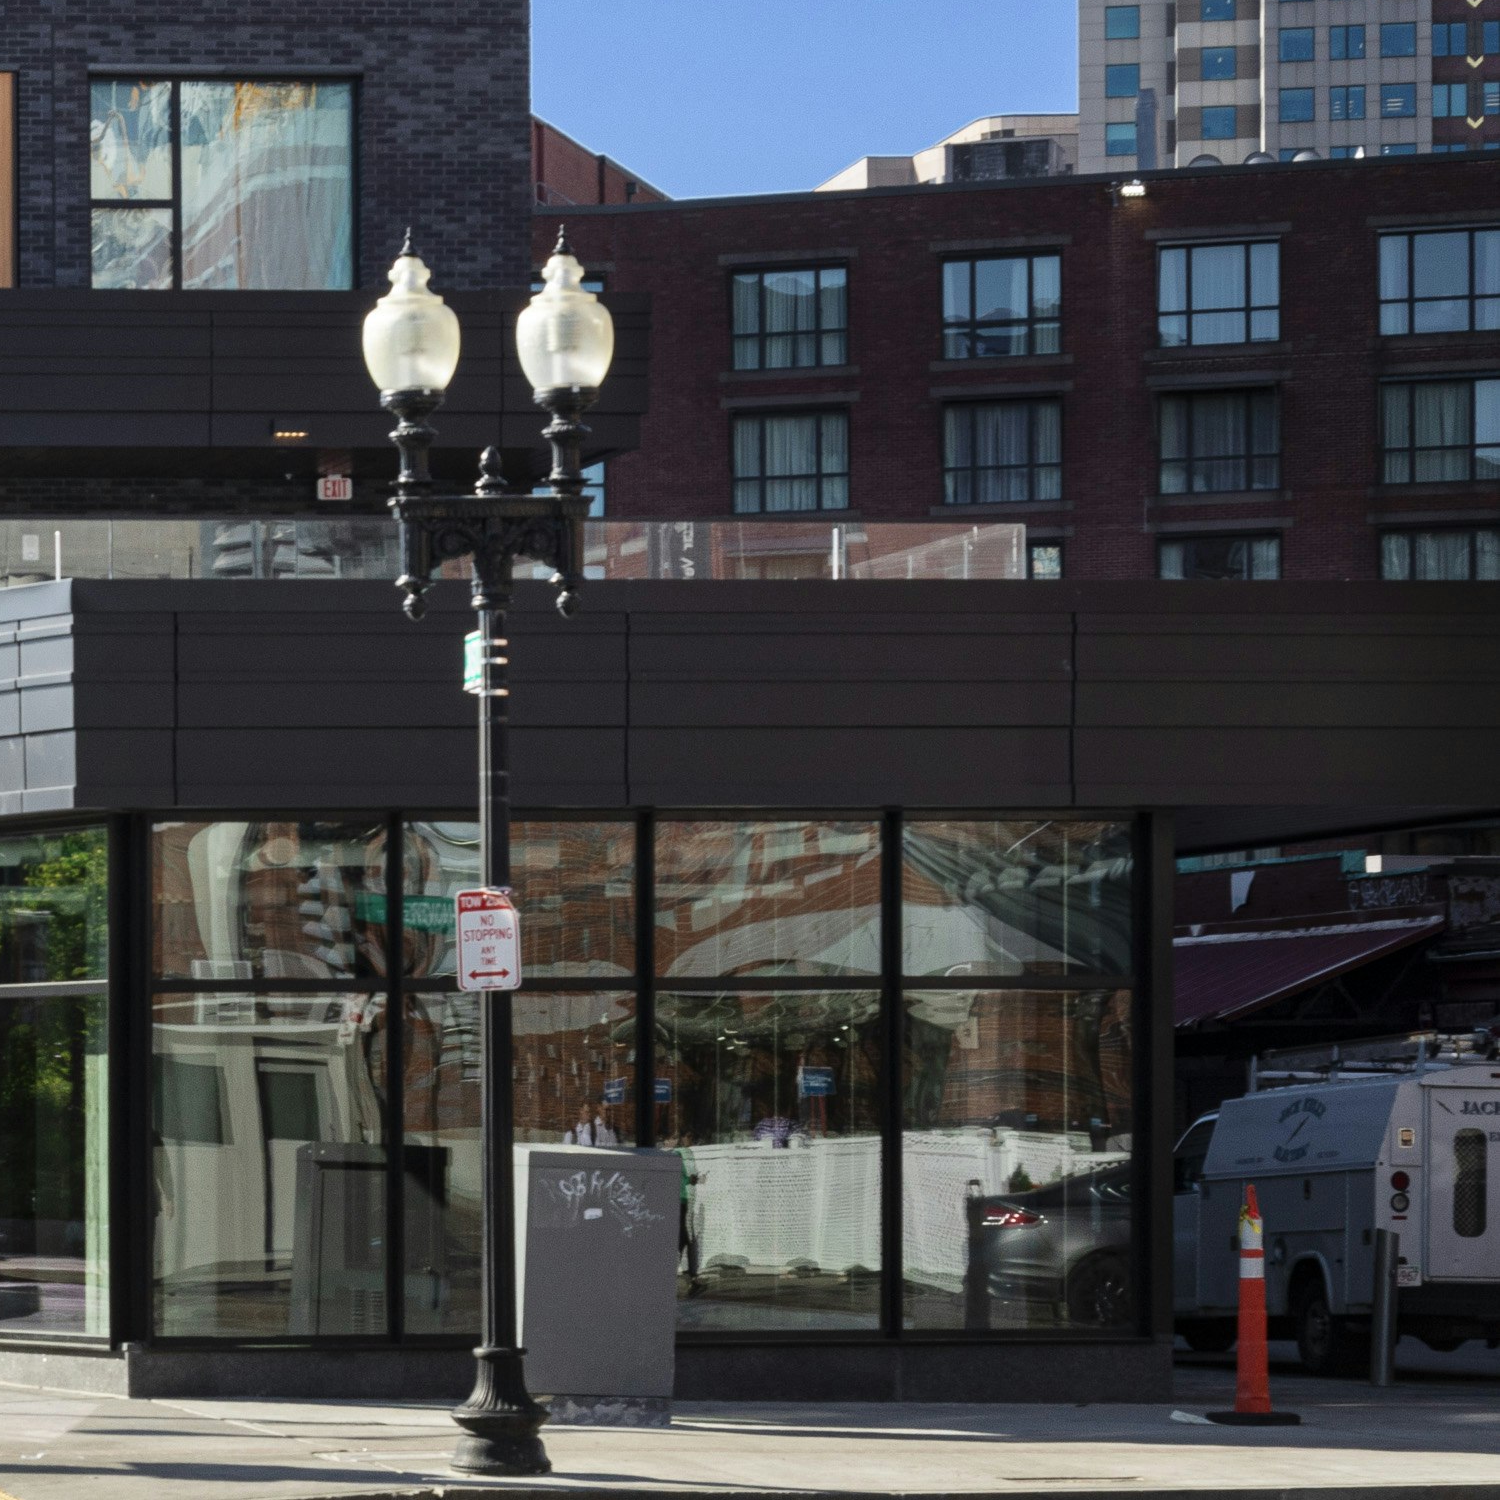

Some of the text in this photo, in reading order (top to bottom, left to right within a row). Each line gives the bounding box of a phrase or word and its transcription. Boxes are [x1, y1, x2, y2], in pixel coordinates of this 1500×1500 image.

[324, 479, 347, 498] EXIT
[461, 896, 482, 909] TOW
[480, 914, 495, 927] NO
[464, 927, 513, 942] STOPPING
[481, 945, 496, 955] ANY
[481, 957, 497, 966] TIME
